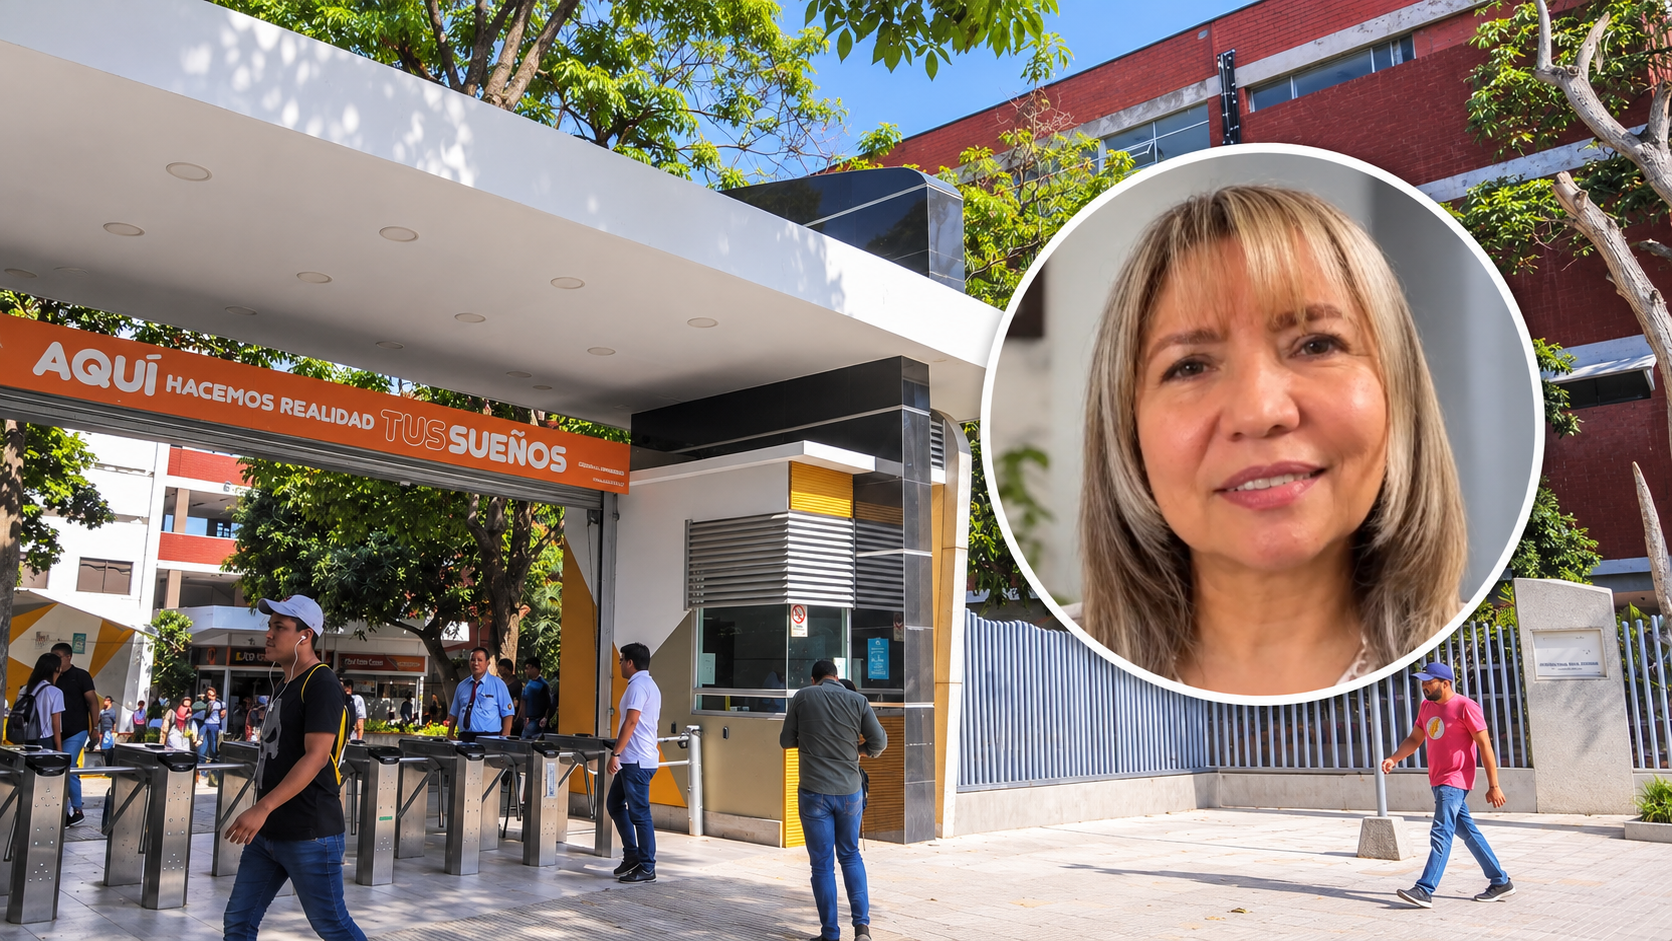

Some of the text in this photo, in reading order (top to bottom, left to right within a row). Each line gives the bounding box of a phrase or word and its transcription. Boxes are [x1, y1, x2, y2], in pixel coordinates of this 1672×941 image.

[32, 341, 568, 474] AQUÍ HACEMOS REALIDAD TUS SUEÑOS
